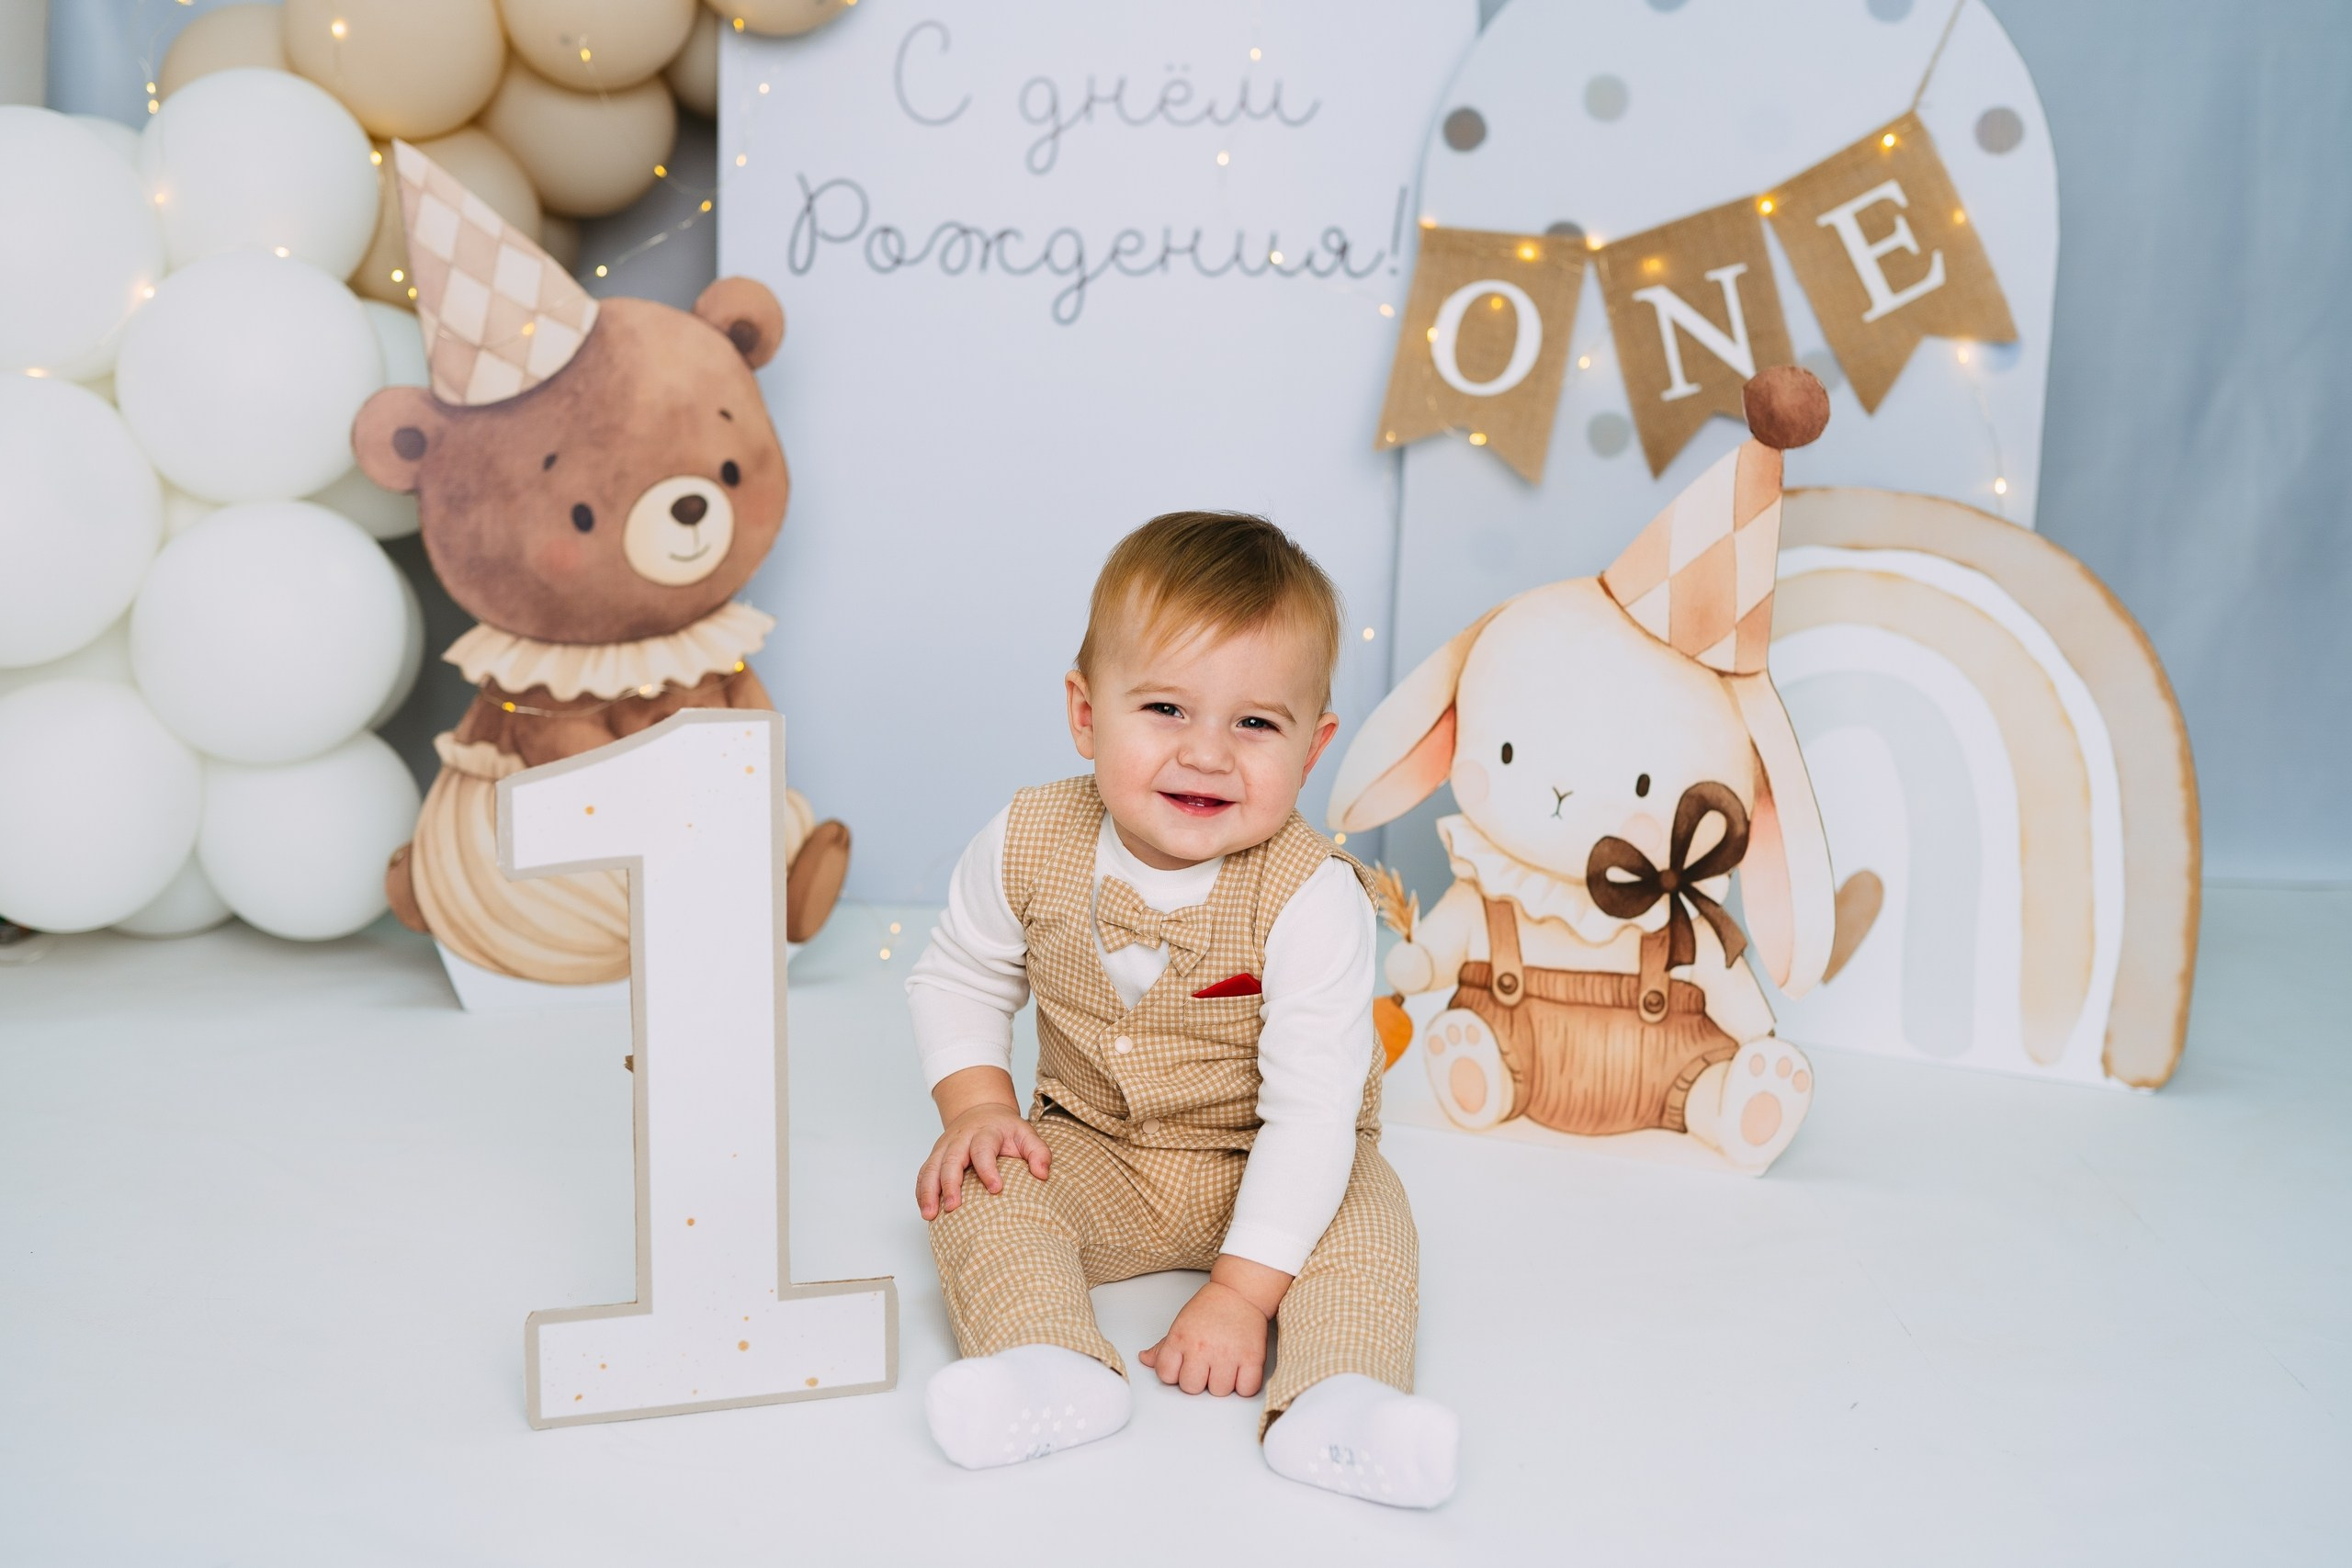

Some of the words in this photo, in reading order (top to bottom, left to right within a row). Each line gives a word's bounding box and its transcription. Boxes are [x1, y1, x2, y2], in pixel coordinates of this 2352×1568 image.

[894, 19, 972, 127] С
[1018, 62, 1322, 175] днём
[787, 171, 1409, 326] Рождения!
[1430, 178, 1948, 402] ONE
[496, 707, 899, 1430] 1
